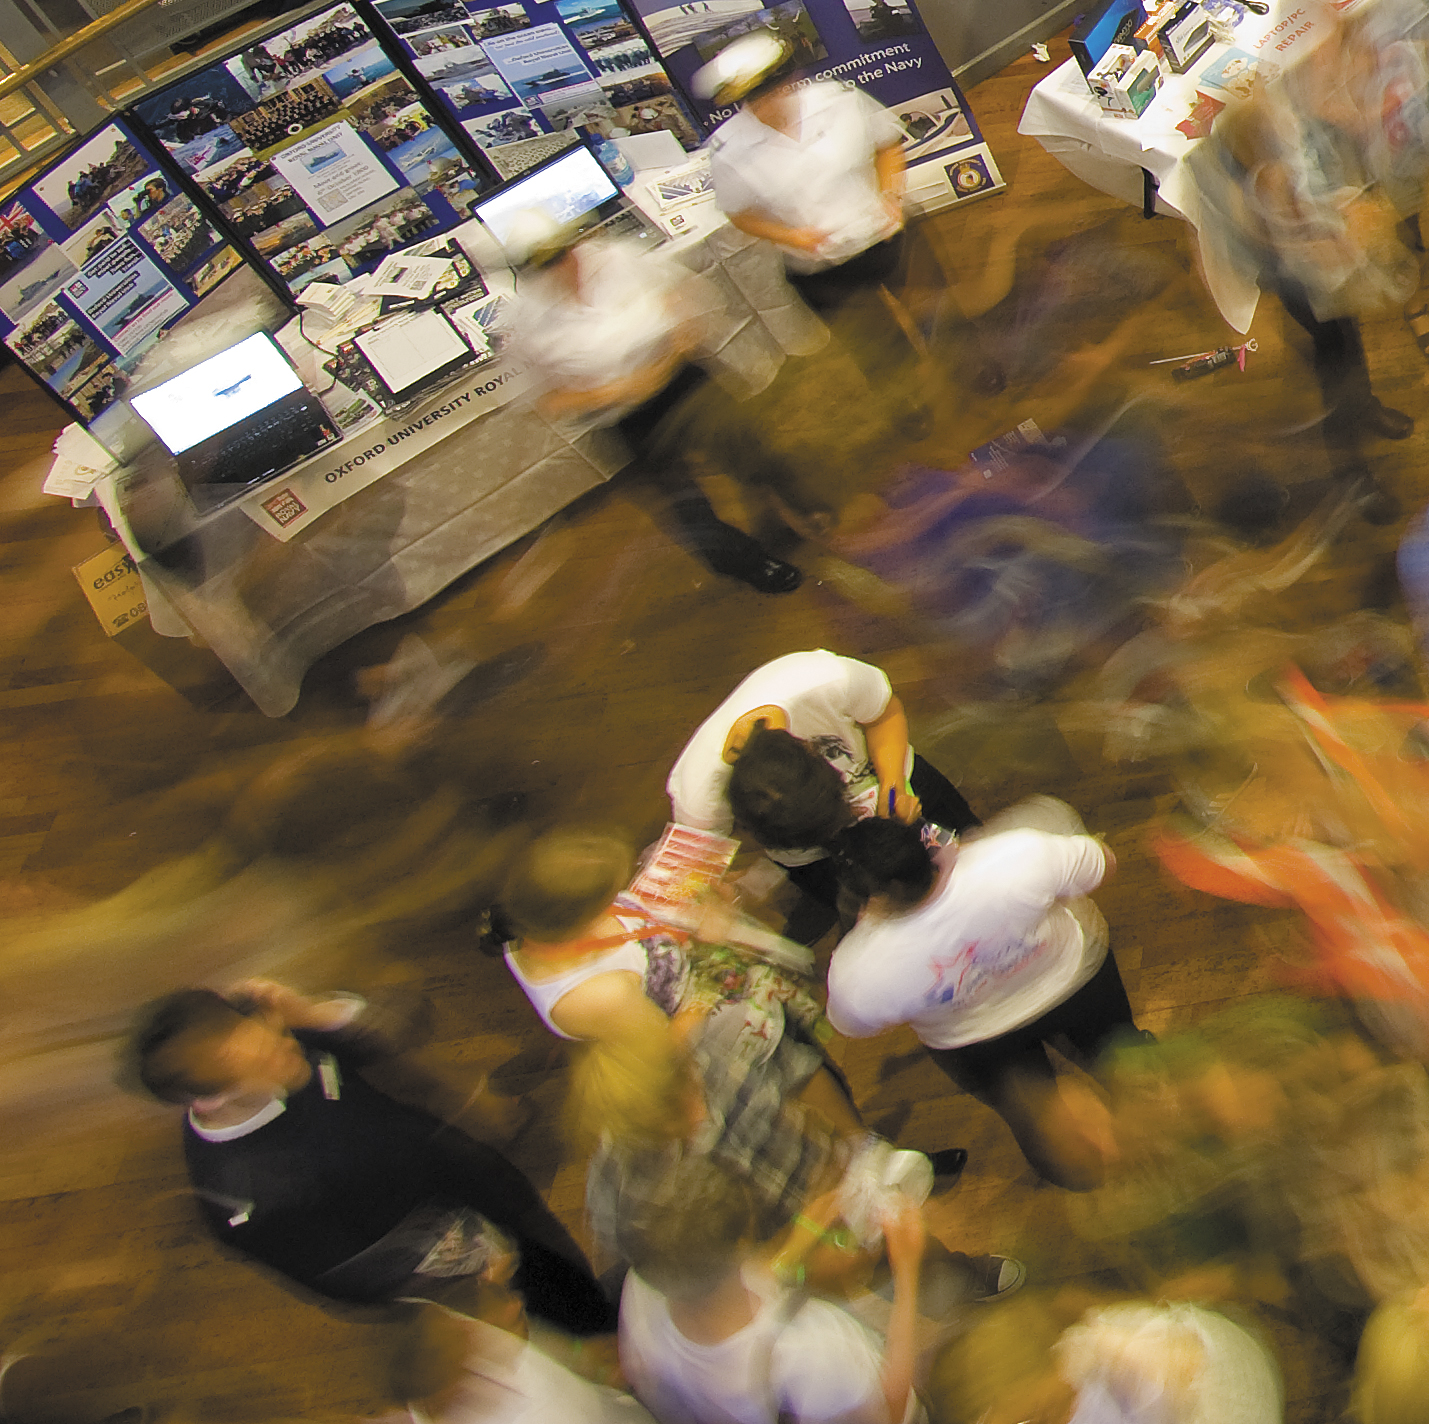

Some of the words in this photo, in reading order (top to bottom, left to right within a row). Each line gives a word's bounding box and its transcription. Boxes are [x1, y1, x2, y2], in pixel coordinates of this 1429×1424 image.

[1253, 8, 1306, 50] LAPTOP/PC
[1275, 20, 1315, 52] REPAIR
[815, 42, 911, 82] commitment
[857, 68, 884, 85] the
[884, 55, 923, 75] Navy
[709, 108, 732, 125] No
[325, 443, 386, 484] OXFORD
[387, 392, 472, 446] UNIVERSITY
[474, 366, 523, 398] ROYAL
